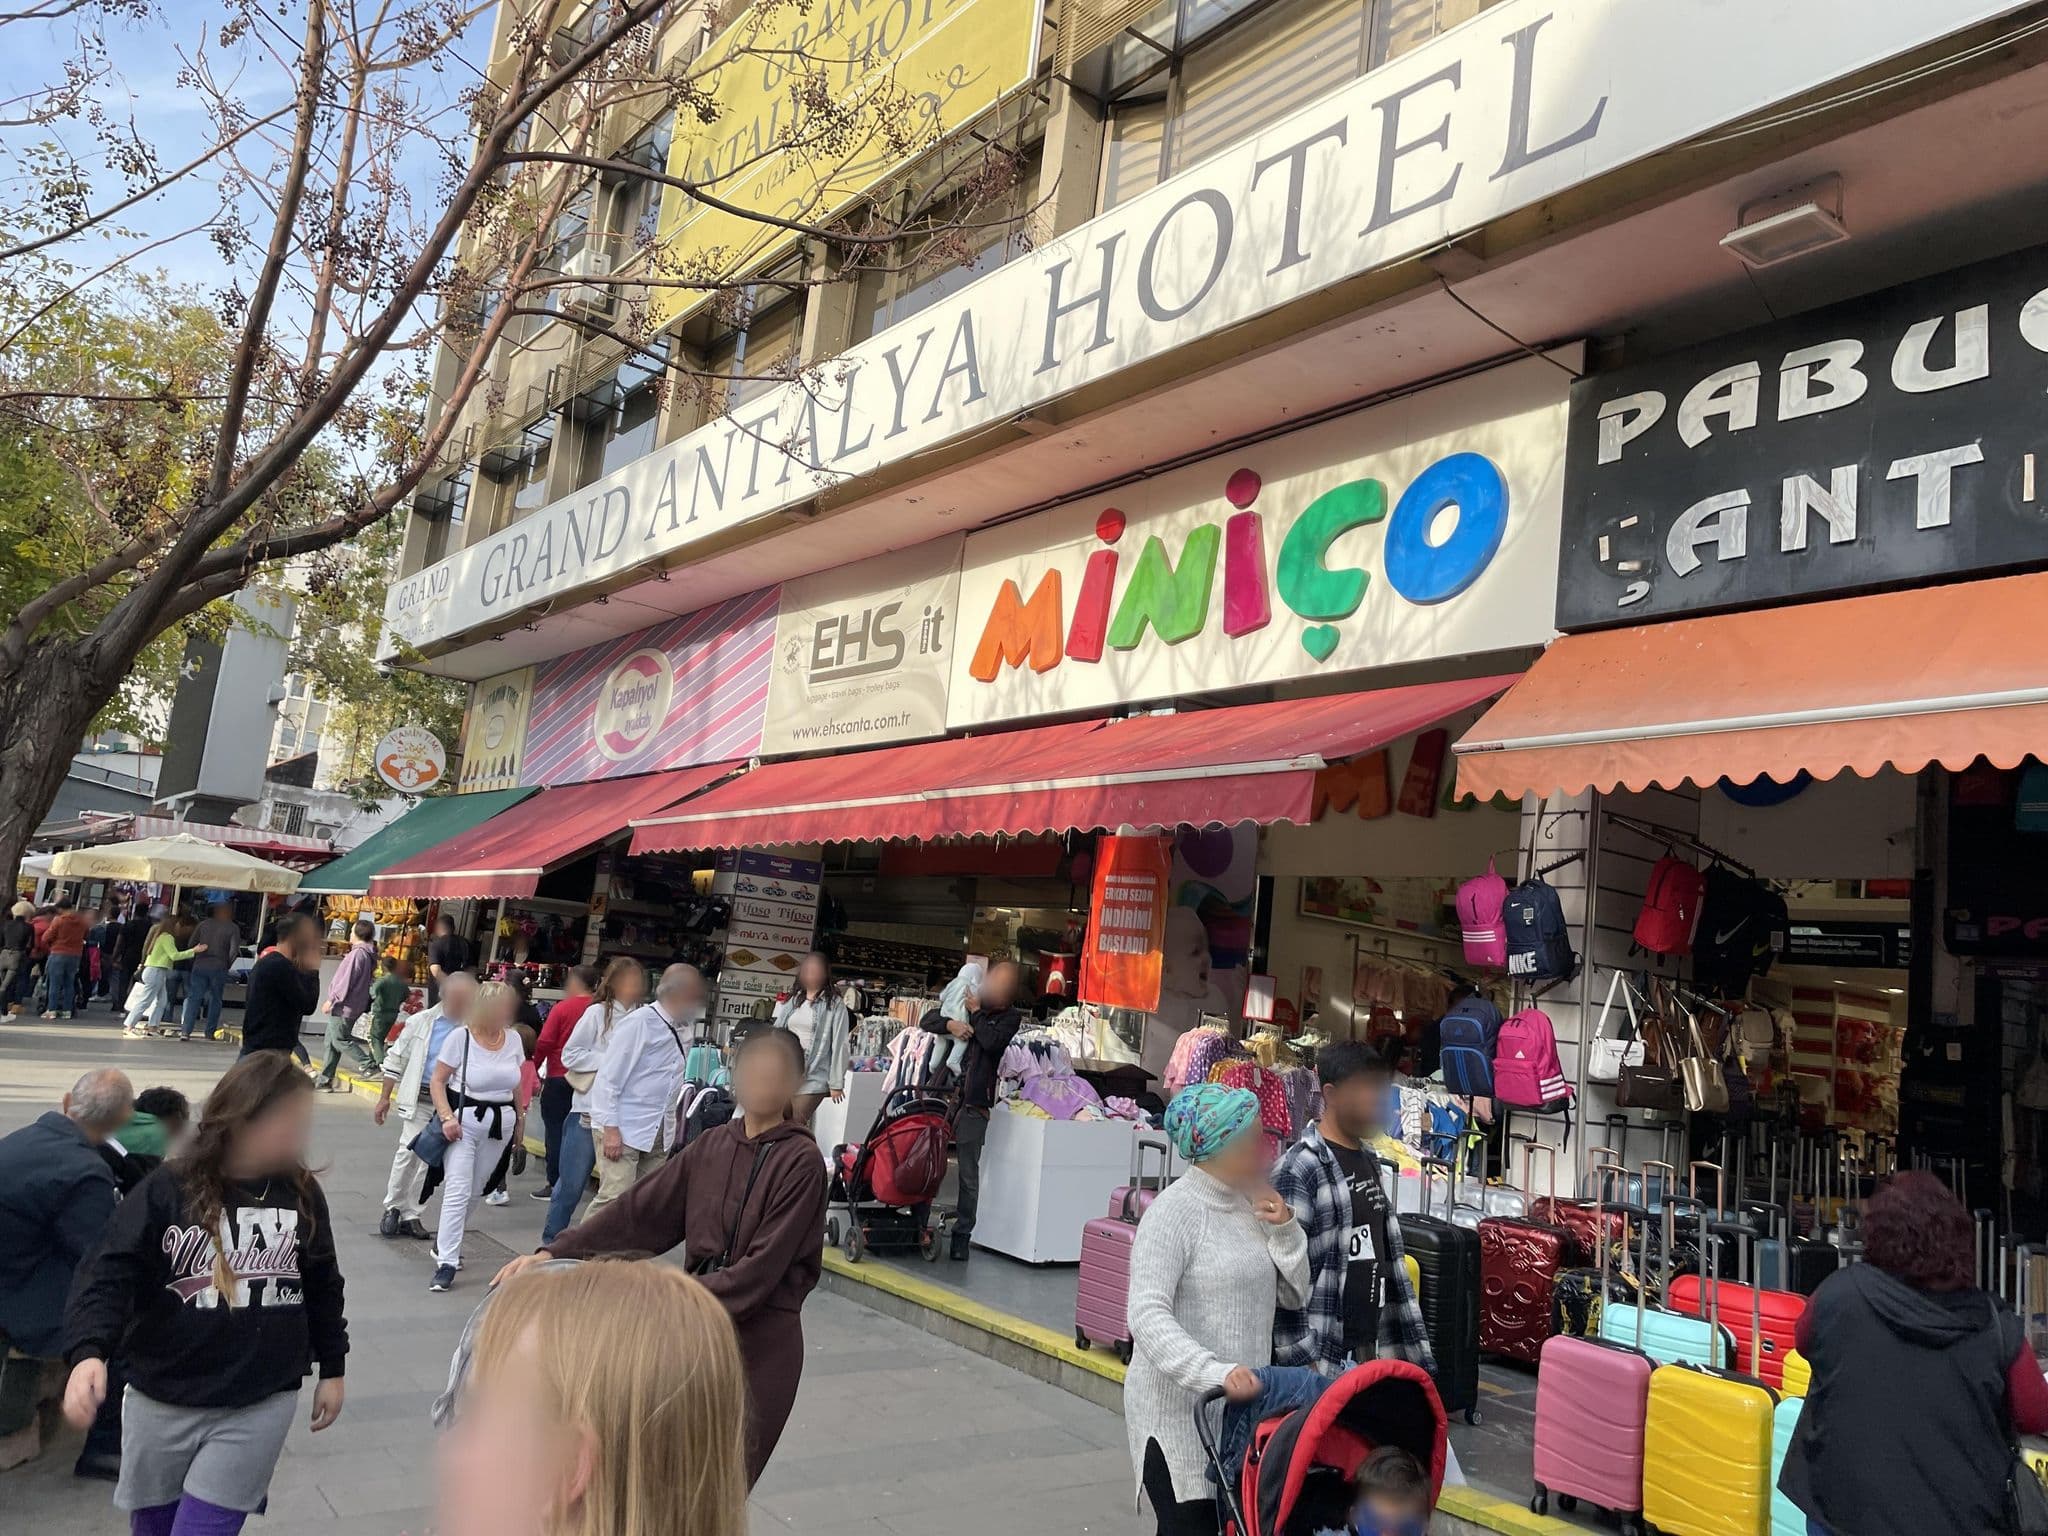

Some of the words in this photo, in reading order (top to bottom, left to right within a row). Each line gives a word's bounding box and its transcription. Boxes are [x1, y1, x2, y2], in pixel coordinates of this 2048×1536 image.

[480, 484, 631, 608] GRAND
[644, 307, 988, 543] ANTALYA
[1033, 12, 1609, 377] HOTEL
[399, 566, 449, 611] GRAND
[809, 601, 906, 685] EHS
[778, 906, 813, 923] Tifoso
[1508, 951, 1537, 975] NIKE
[722, 998, 752, 1015] Tratt
